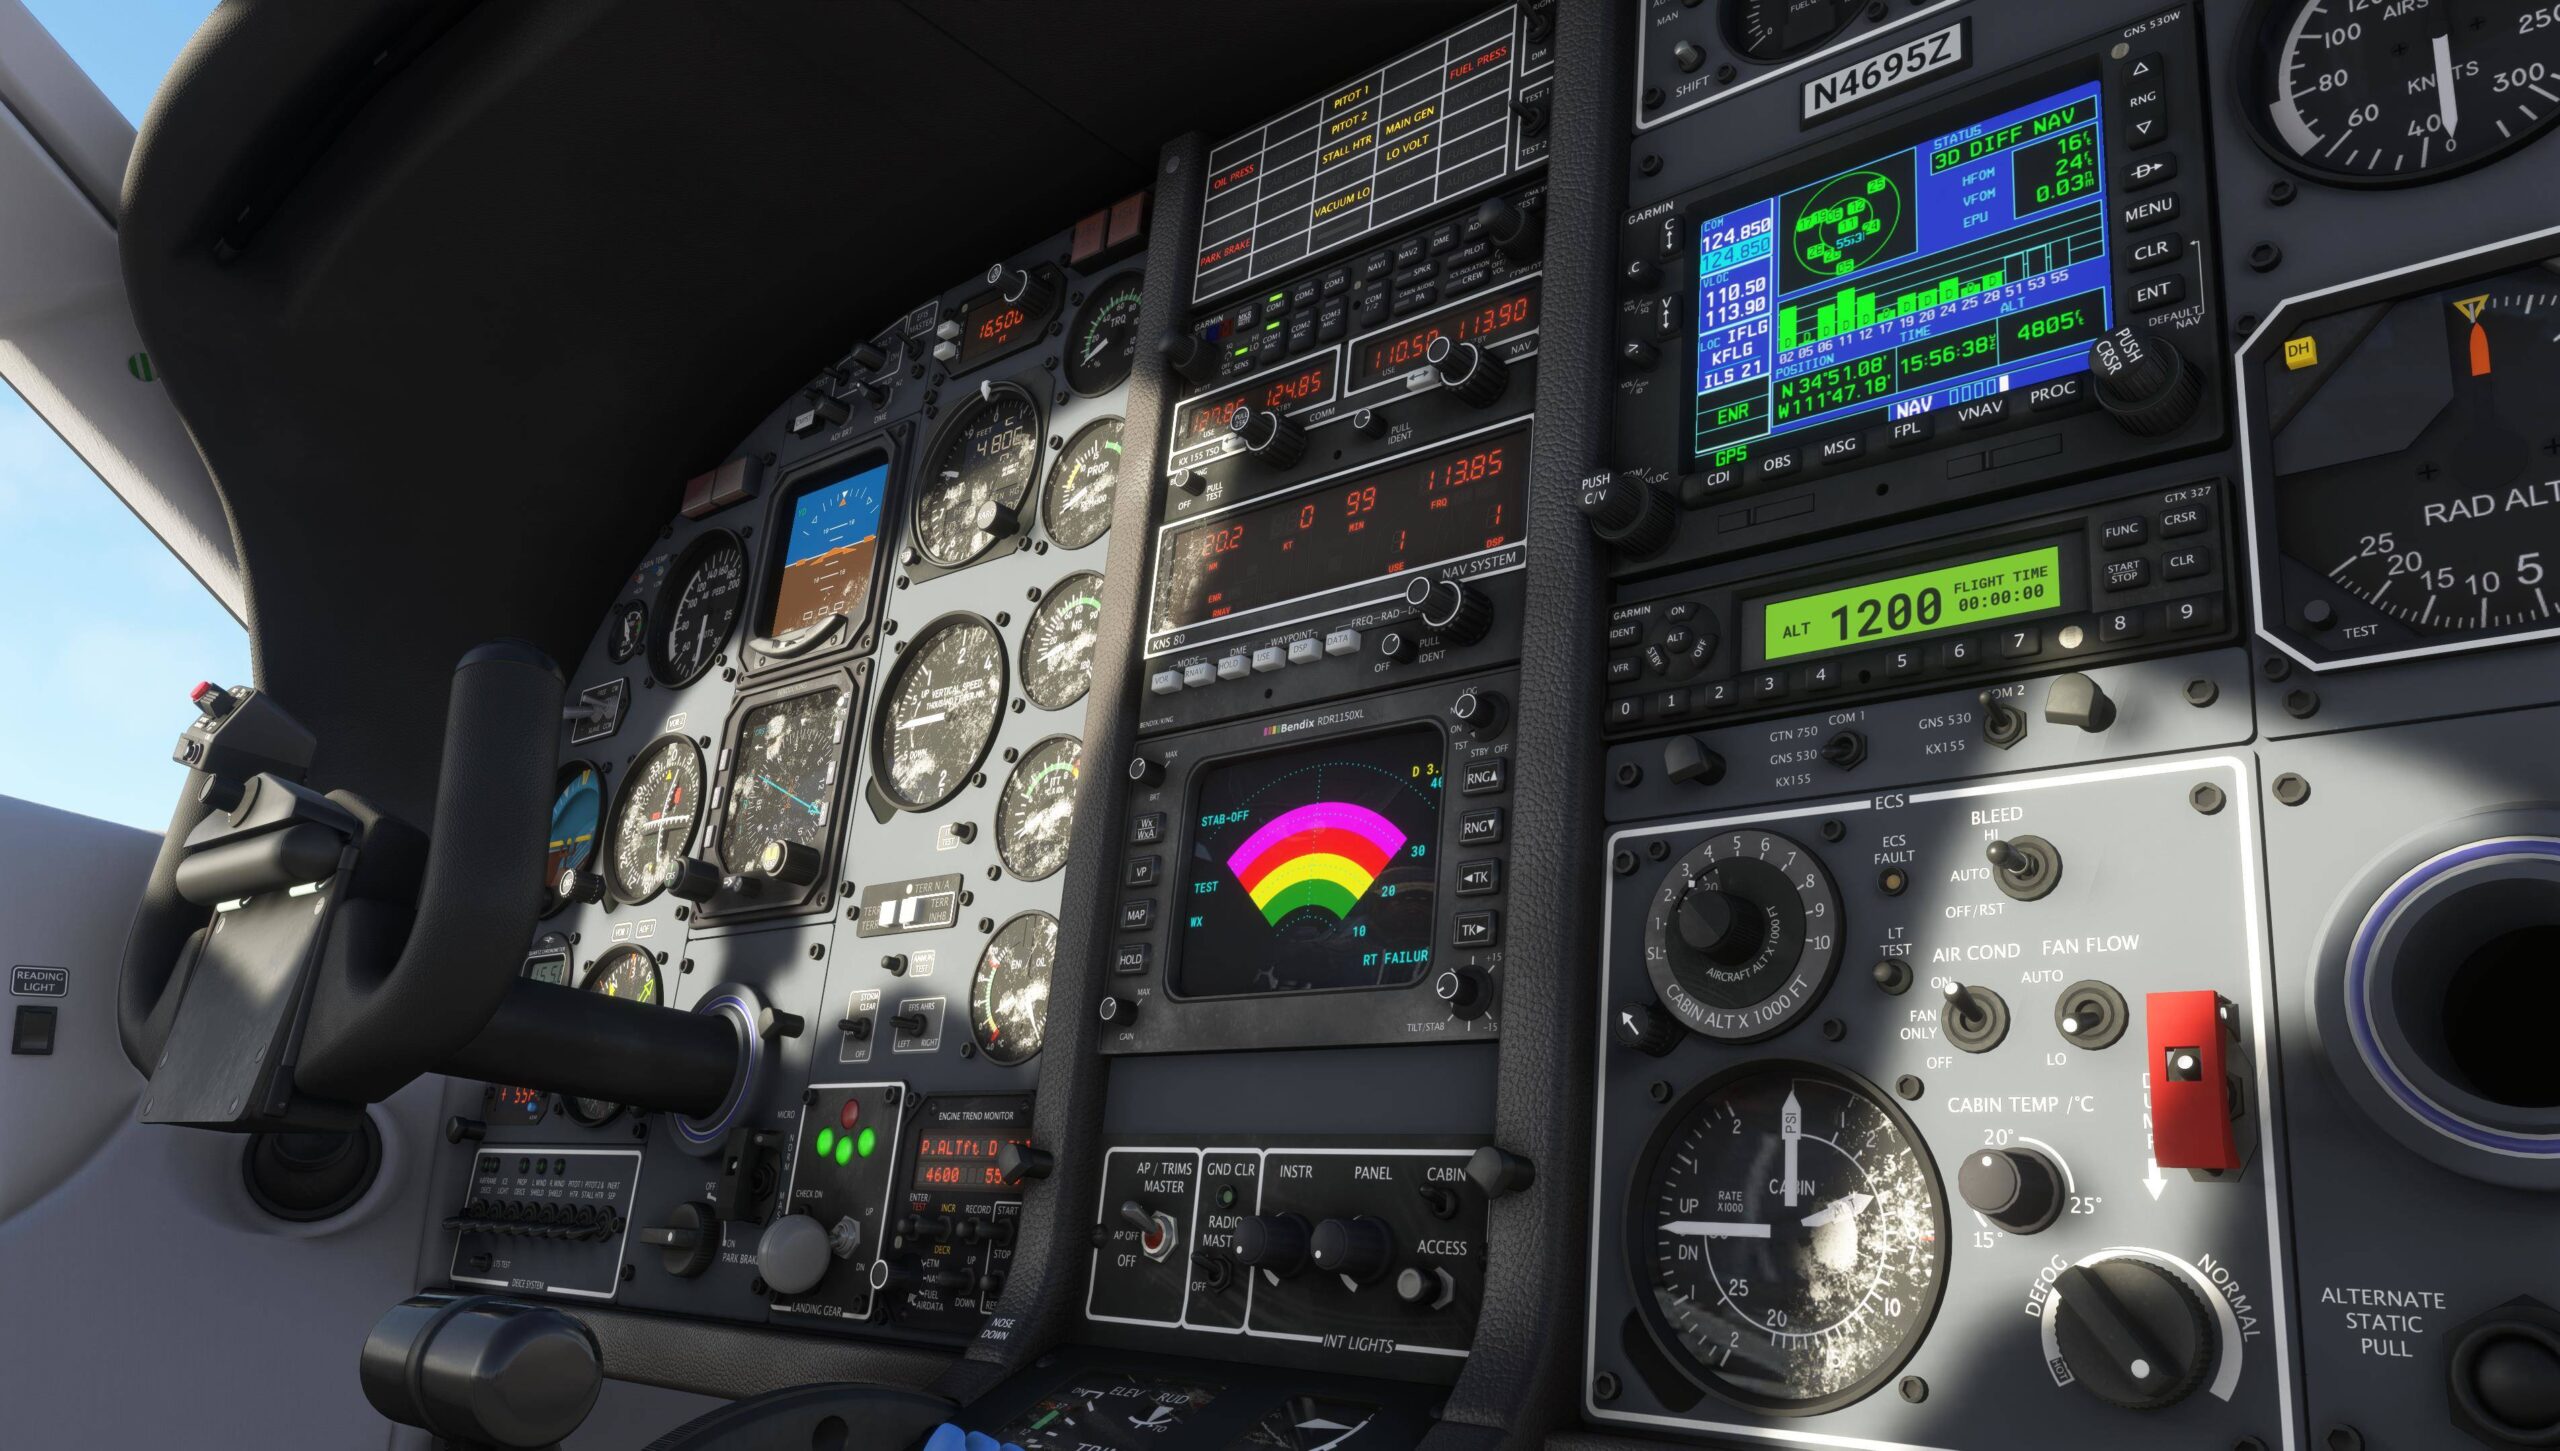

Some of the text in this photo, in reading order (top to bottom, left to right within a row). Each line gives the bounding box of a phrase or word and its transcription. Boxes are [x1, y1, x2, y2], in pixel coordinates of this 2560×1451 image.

[2124, 11, 2181, 38] GNS 530W
[2324, 23, 2362, 48] 100
[1450, 46, 1507, 80] FUEL PRESS
[1813, 31, 1951, 110] N4695Z
[1676, 75, 1709, 98] SHIFT
[2318, 70, 2349, 92] 80
[2493, 62, 2545, 93] 300
[1334, 85, 1369, 109] PITOT 1
[1332, 111, 1368, 135] PITOT 2
[1386, 106, 1435, 135] MAIN GEN
[1934, 124, 1982, 150] STATUS
[1935, 108, 2075, 169] 3D DIFF NAV
[1322, 134, 1372, 164] STALL HTR
[1386, 134, 1429, 160] LO VOLT
[1213, 164, 1254, 189] OIL PRESS
[1962, 167, 1996, 187] HFOM
[1314, 187, 1370, 218] VACUUM LO
[1963, 188, 1996, 206] VFOM
[1628, 201, 1674, 225] GARMIN
[2126, 198, 2173, 223] MENU
[1703, 217, 1771, 253] 124.850
[1200, 239, 1251, 267] PARK BRAKE
[2134, 241, 2169, 261] CLR
[1707, 277, 1766, 305] 110.50
[2137, 282, 2171, 302] ENT
[1706, 297, 1765, 327] 113.90
[2001, 296, 2026, 314] ALT
[1459, 298, 1527, 339] 113.90
[2149, 306, 2200, 327] DEFAULT
[1700, 320, 1768, 352] LOC IFLG
[1901, 324, 1931, 343] TIME
[1712, 343, 1753, 366] KFLG
[1901, 335, 1988, 374] 15:56:38
[2116, 328, 2143, 364] PUSH
[2288, 342, 2309, 358] DH
[1776, 354, 1834, 379] POSITION
[2096, 341, 2122, 376] CRSR
[1705, 360, 1761, 388] ILS 21
[1267, 371, 1322, 406] 124.85
[2030, 381, 2075, 404] PROC
[1309, 407, 1336, 422] COMM
[1718, 403, 1749, 424] ENR
[1897, 396, 1933, 420] NAV
[1959, 400, 2003, 421] VNAV
[1894, 422, 1921, 439] FPL
[1716, 446, 1747, 467] GPS
[1824, 438, 1856, 457] MSG
[1429, 449, 1503, 491] 113.85
[1764, 455, 1791, 472] OBS
[1582, 473, 1611, 490] PUSH
[1708, 471, 1730, 486] CDI
[1346, 487, 1377, 515] 99
[2165, 486, 2211, 503] GTX 327
[2424, 480, 2560, 525] RAD ALT
[2164, 511, 2197, 526] CRSR
[2105, 523, 2138, 538] FUNC
[2360, 532, 2394, 557] 25
[1442, 552, 1516, 580] NAV SYSTEM
[2108, 561, 2140, 574] START
[2388, 552, 2422, 575] 20
[1954, 566, 2048, 594] FLIGHT TIME
[2111, 572, 2138, 584] STOP
[1958, 584, 2044, 612] 00:00:00
[1613, 605, 1651, 620] GARMIN
[1671, 606, 1684, 616] ON
[1783, 587, 1942, 640] ALT 1200
[1270, 631, 1314, 647] WAYPOINT
[1610, 627, 1635, 639] IDENT
[1667, 632, 1684, 643] ALT
[2343, 624, 2378, 638] TEST
[1153, 633, 1185, 651] KNS 80
[1280, 710, 1364, 733] Bendix RDR1150XL
[1770, 726, 1818, 742] GTN 750
[1468, 772, 1489, 785] RNG
[1876, 794, 1904, 809] ECS
[1201, 809, 1250, 827] STAB-OFF
[1972, 807, 2023, 825] BLEED
[1464, 821, 1487, 834] RNG
[1984, 829, 1998, 841] HI
[1883, 835, 1906, 848] ECS
[1874, 850, 1915, 865] FAULT
[1951, 868, 1990, 882] AUTO
[916, 883, 932, 893] TERR
[1195, 881, 1218, 893] TEST
[931, 897, 948, 908] TERR
[1945, 903, 2005, 918] OFF/RST
[929, 911, 947, 921] INHB
[1128, 909, 1145, 921] MAP
[1932, 943, 2021, 963] AIR COND
[2042, 935, 2140, 956] FAN FLOW
[1120, 954, 1141, 965] HOLD
[1363, 953, 1379, 966] RT
[18, 972, 63, 981] READING
[2021, 969, 2064, 984] AUTO
[24, 983, 55, 992] LIGHT
[1910, 1010, 1937, 1021] FAN
[1901, 1027, 1938, 1040] ONLY
[1948, 1097, 2002, 1113] CABIN
[2009, 1096, 2059, 1113] TEMP
[939, 1111, 1013, 1121] ENGINE TREND MONITOR
[926, 1168, 959, 1182] 4600
[1137, 1162, 1192, 1175] AP TRIMS
[1207, 1163, 1255, 1176] GND CLR
[1280, 1165, 1313, 1178] INSTR
[1354, 1166, 1393, 1181] PANEL
[1427, 1168, 1466, 1182] CABIN
[1144, 1181, 1184, 1193] MASTER
[1417, 1240, 1467, 1255] ACCESS
[2024, 1253, 2067, 1318] DEFOG
[2197, 1253, 2262, 1342] NORMAL
[2321, 1287, 2447, 1309] ALTERNATE
[792, 1303, 841, 1316] LANDING GEAR
[992, 1318, 1014, 1327] NOSE
[2346, 1312, 2423, 1333] STATIC
[1324, 1334, 1394, 1353] INT LIGHTS
[2362, 1337, 2413, 1357] PULL
